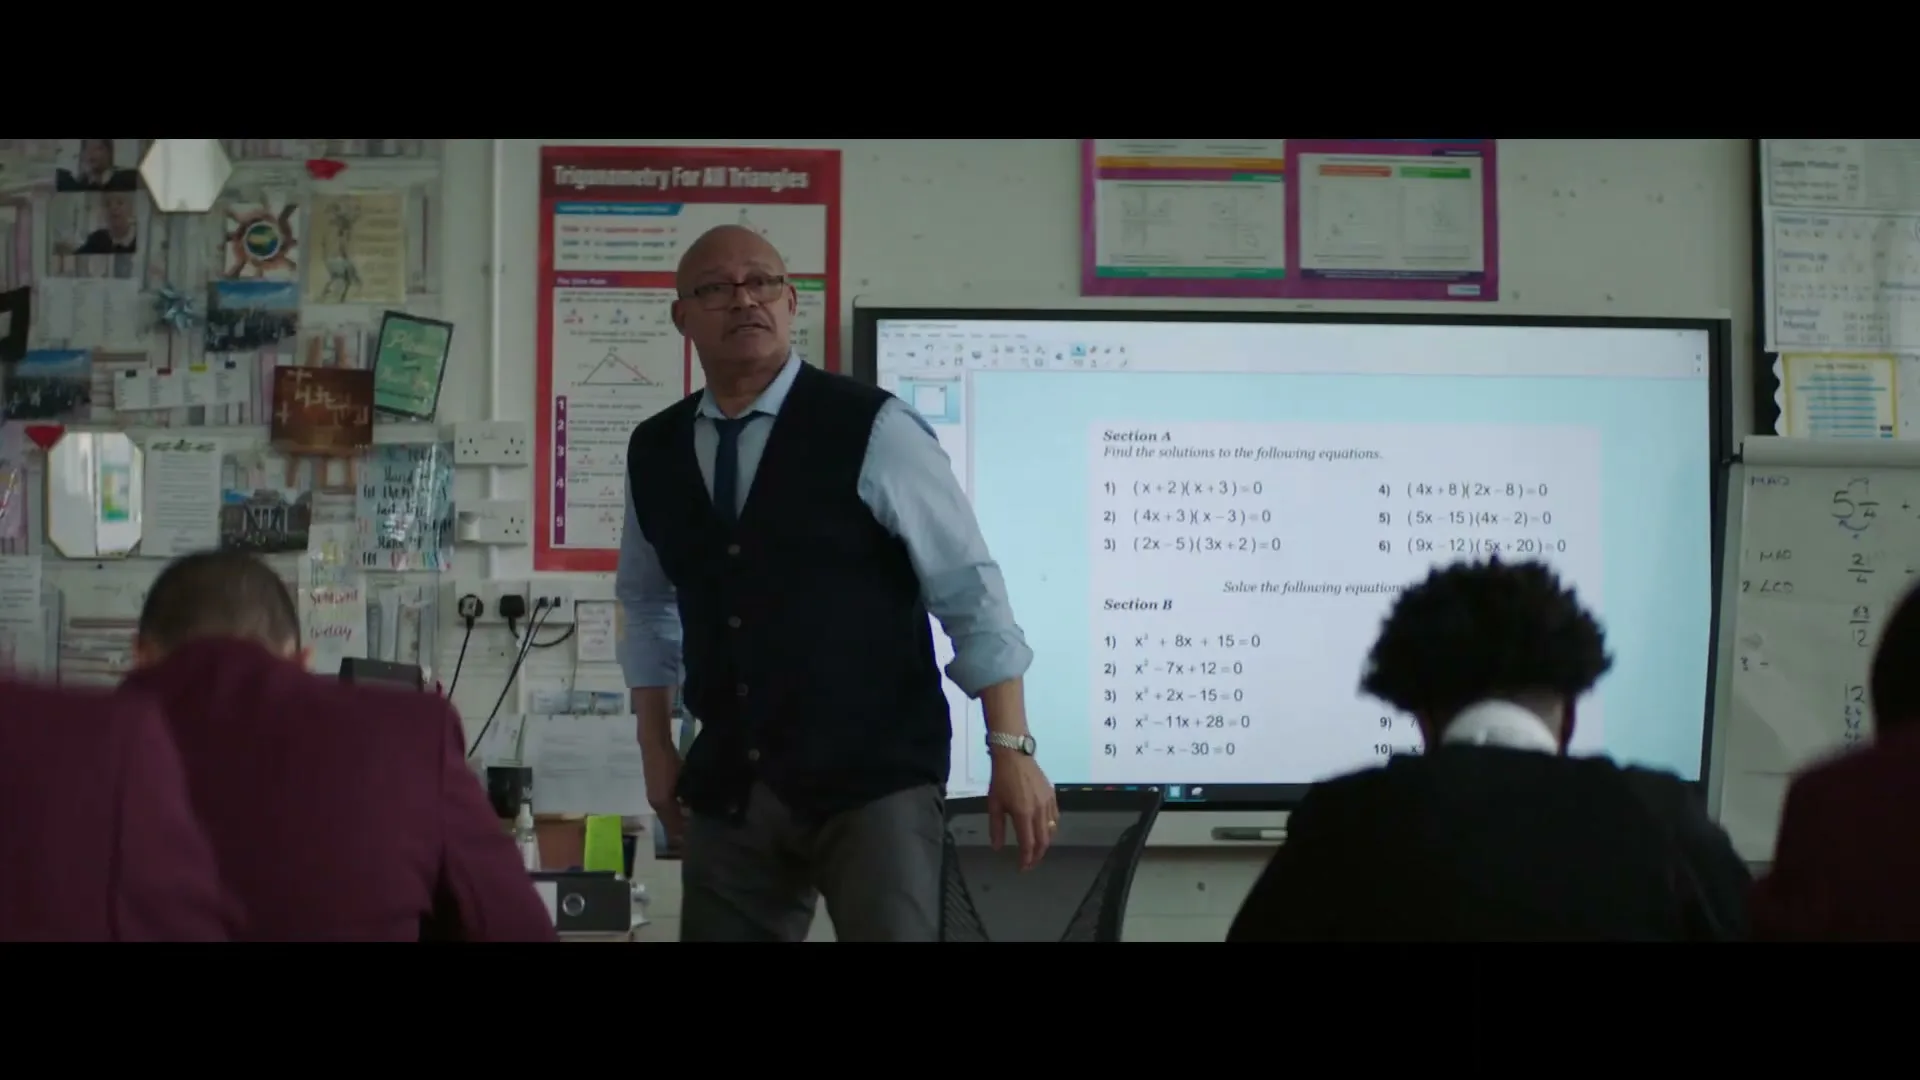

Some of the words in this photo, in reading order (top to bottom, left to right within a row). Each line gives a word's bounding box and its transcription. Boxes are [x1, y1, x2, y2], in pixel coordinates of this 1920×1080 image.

[553, 165, 669, 191] Trigonometry
[672, 167, 699, 187] For
[702, 166, 726, 187] All
[729, 167, 809, 192] Triangles
[1103, 430, 1158, 442] Section
[1161, 430, 1172, 442] A
[1103, 446, 1133, 459] Find
[1136, 446, 1156, 458] the
[1159, 446, 1215, 459] solutions
[1218, 448, 1231, 459] to
[1234, 447, 1253, 459] the
[1255, 446, 1316, 462] following
[1105, 482, 1115, 495] 1)
[1379, 485, 1390, 496] 4)
[1832, 489, 1855, 519] 5
[1104, 511, 1115, 524] 2)
[1379, 512, 1390, 525] 5)
[1514, 512, 1528, 527] 2)
[1105, 539, 1115, 551] 3)
[1379, 539, 1391, 554] 6)
[1222, 582, 1257, 594] Solve
[1260, 582, 1280, 594] the
[1281, 582, 1341, 597] following
[1103, 599, 1158, 611] Section
[1161, 599, 1173, 610] B
[1105, 636, 1116, 649] 1)
[1105, 663, 1116, 676] 2)
[1105, 690, 1116, 703] 3)
[1105, 717, 1116, 729] 4)
[1380, 716, 1392, 731] 9)
[1105, 744, 1116, 756] 5)
[1374, 743, 1393, 756] 10)
